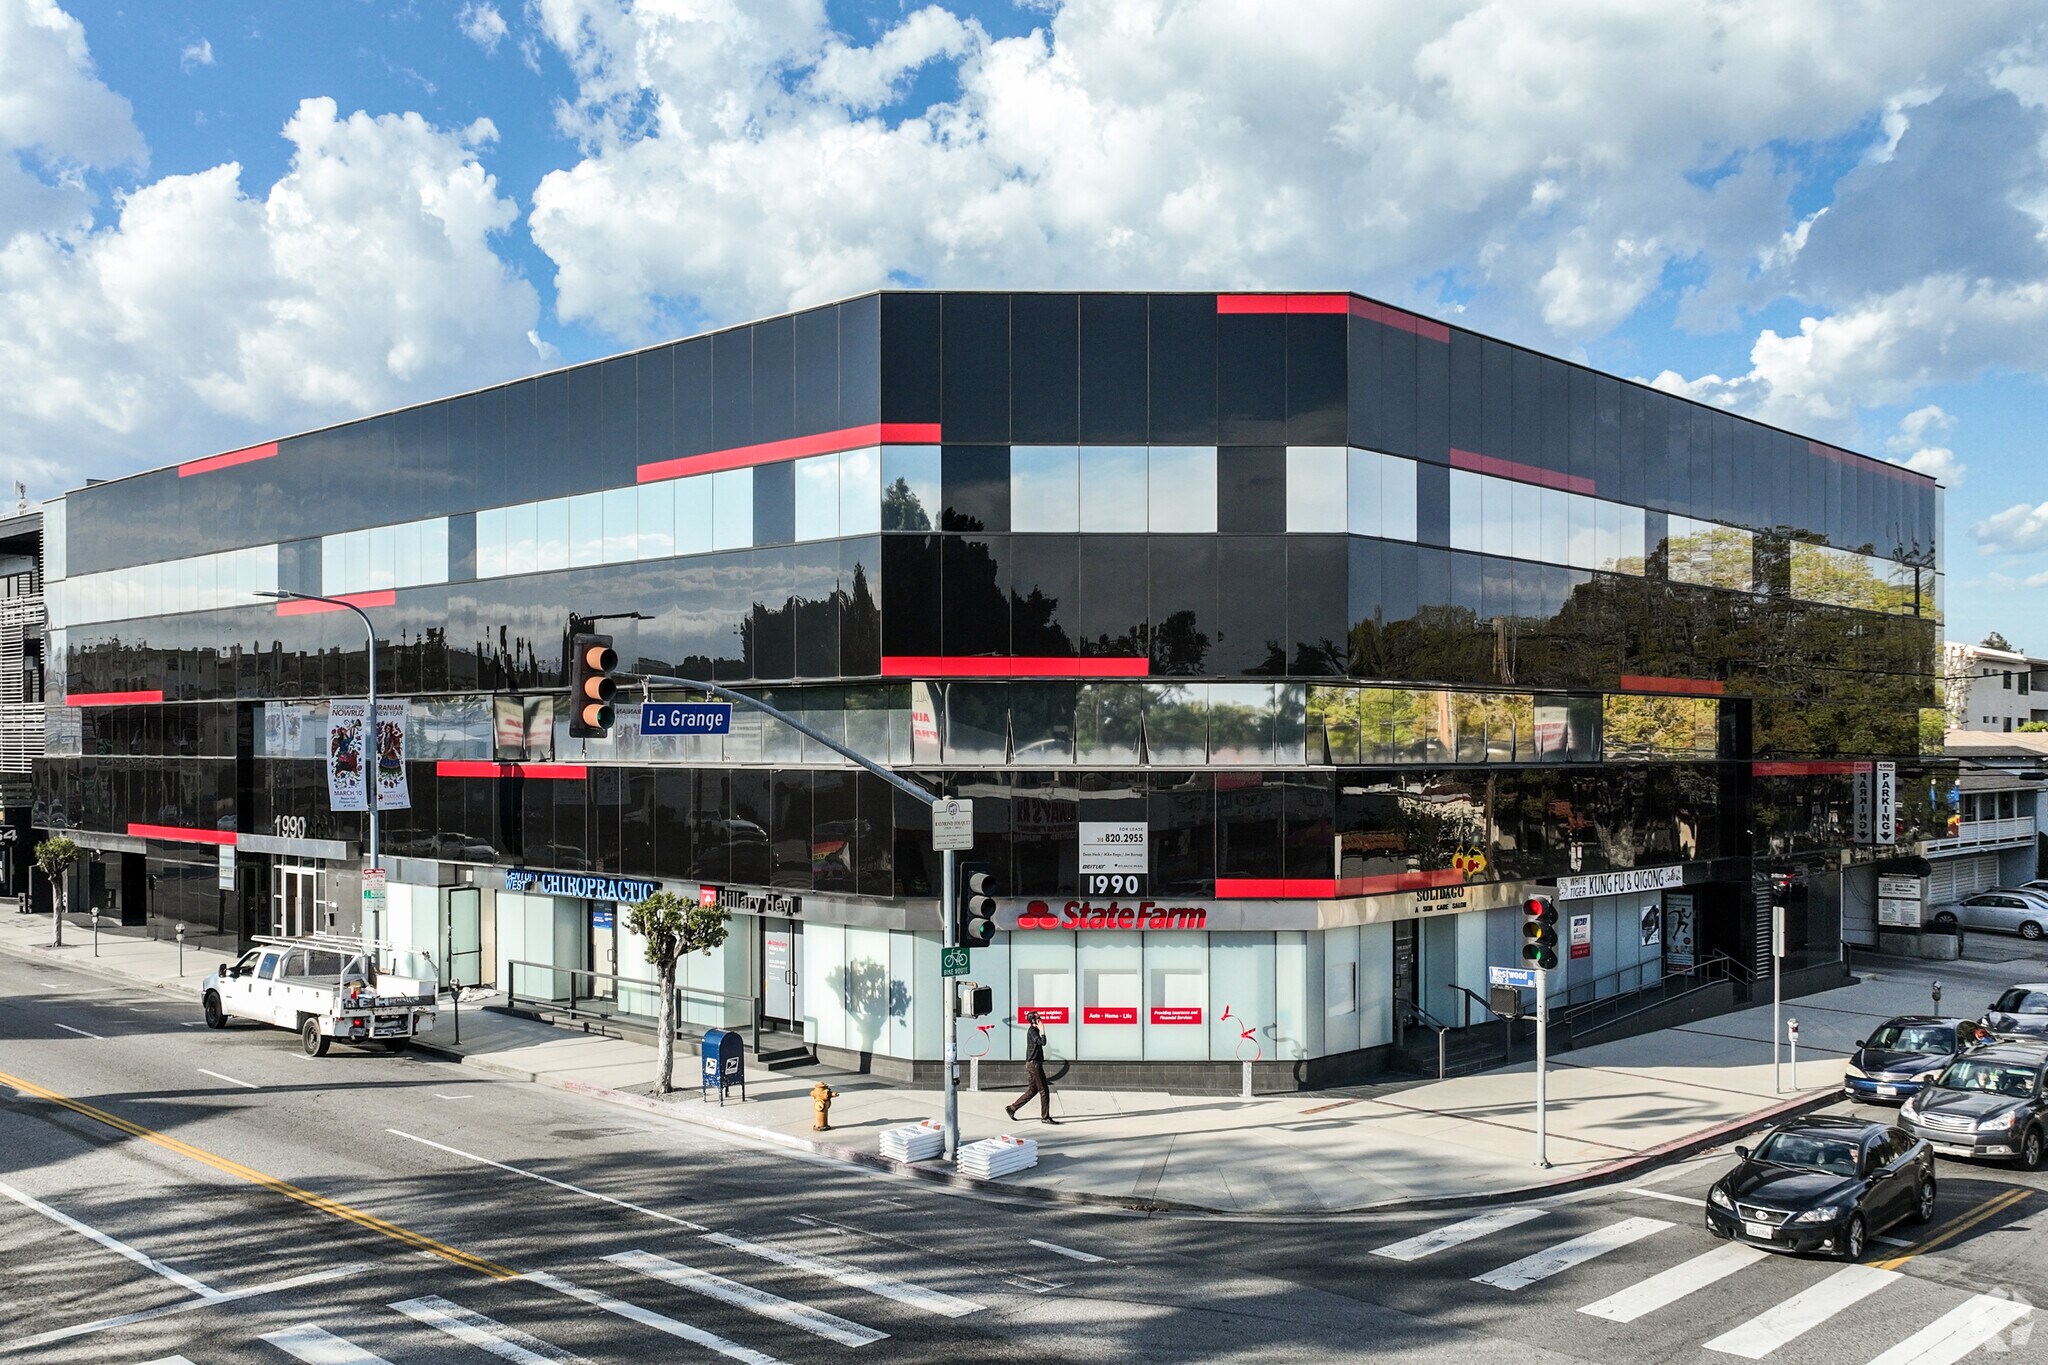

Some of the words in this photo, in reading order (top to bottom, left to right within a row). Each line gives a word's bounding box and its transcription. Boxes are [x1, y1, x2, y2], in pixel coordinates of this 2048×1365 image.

[649, 710, 666, 727] La
[670, 709, 724, 731] Grange
[1882, 772, 1890, 830] PARKING
[274, 814, 306, 839] 1990
[1105, 833, 1143, 843] 820.2955
[505, 879, 526, 891] WEST
[505, 869, 538, 883] CENTURY
[542, 872, 654, 902] CHIROPRACTIC
[1089, 874, 1139, 894] 1990
[1570, 876, 1586, 887] WHITE
[1570, 886, 1586, 897] TIGER
[1589, 874, 1612, 895] KUNG
[1614, 873, 1625, 892] FU
[1627, 873, 1632, 890] &
[1634, 869, 1664, 890] QIGONG
[720, 890, 760, 914] Hillary
[1416, 886, 1465, 902] SOLIDAGO
[766, 893, 793, 916] Heyl
[1436, 903, 1449, 911] CARE
[955, 966, 968, 974] ROUTE
[1491, 967, 1527, 980] Westwood
